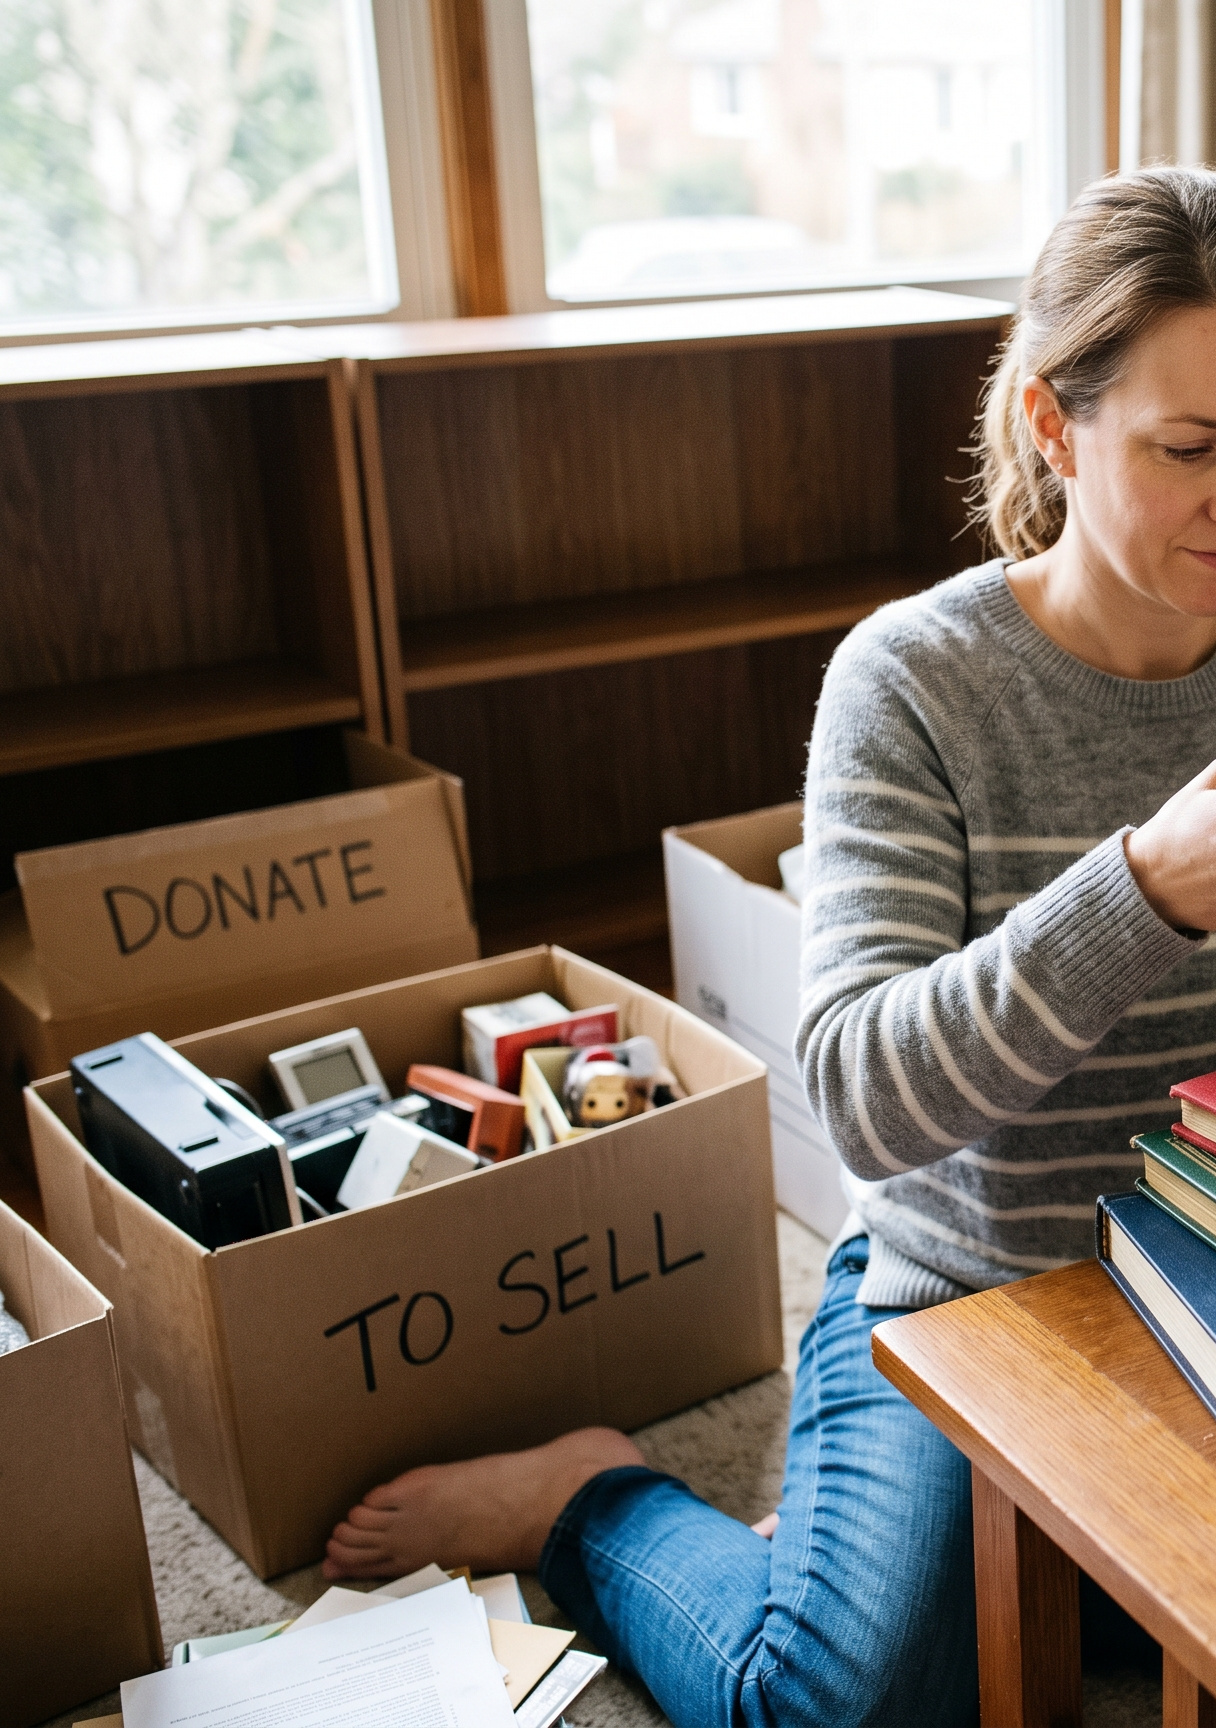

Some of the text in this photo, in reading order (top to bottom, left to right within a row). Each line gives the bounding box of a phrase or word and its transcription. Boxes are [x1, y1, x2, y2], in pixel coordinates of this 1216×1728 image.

[103, 839, 387, 957] DONATE
[323, 1211, 706, 1393] TO SELL
